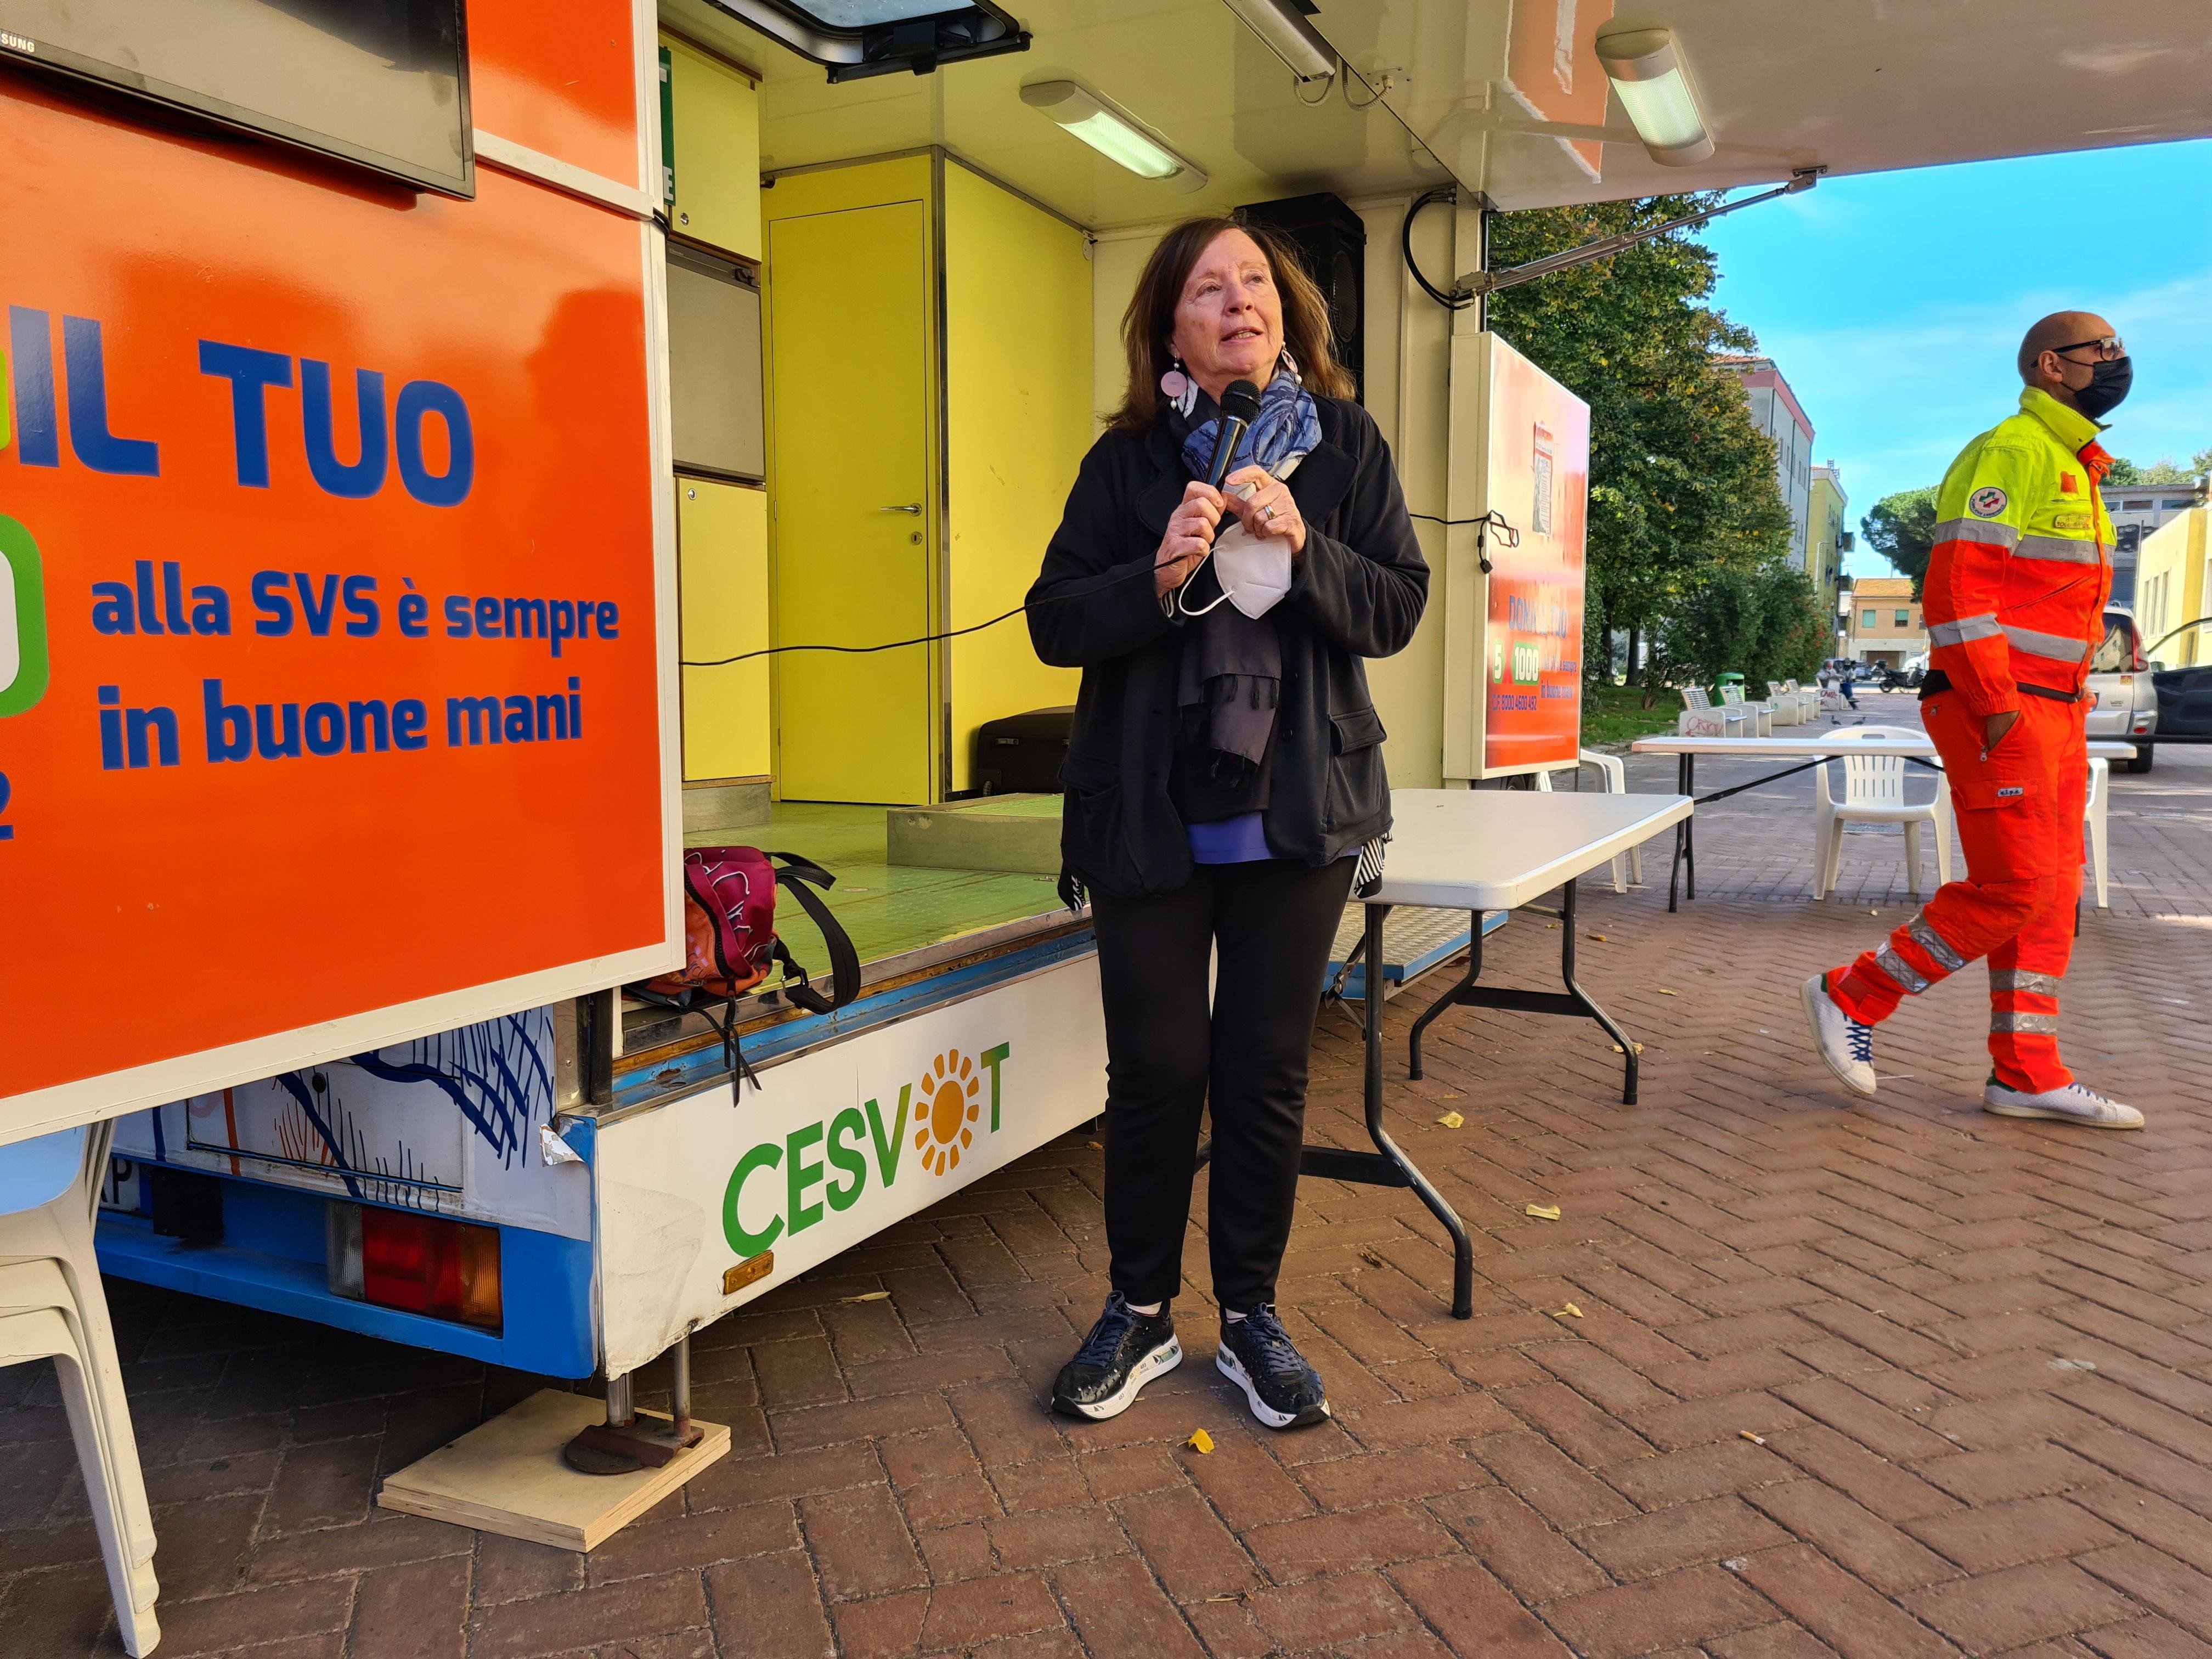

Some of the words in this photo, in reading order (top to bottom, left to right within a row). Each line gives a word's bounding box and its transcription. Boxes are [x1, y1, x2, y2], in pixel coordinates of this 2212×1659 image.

[9, 305, 159, 477] IL
[199, 339, 475, 508] TUO
[92, 560, 231, 637] alla
[252, 571, 380, 637] SVS
[399, 577, 429, 637] è
[445, 595, 619, 658] sempre
[1509, 595, 1537, 633] DONA
[98, 685, 179, 770] in
[204, 679, 428, 763] buone
[447, 677, 582, 747] mani
[723, 1041, 1009, 1258] CESVOT
